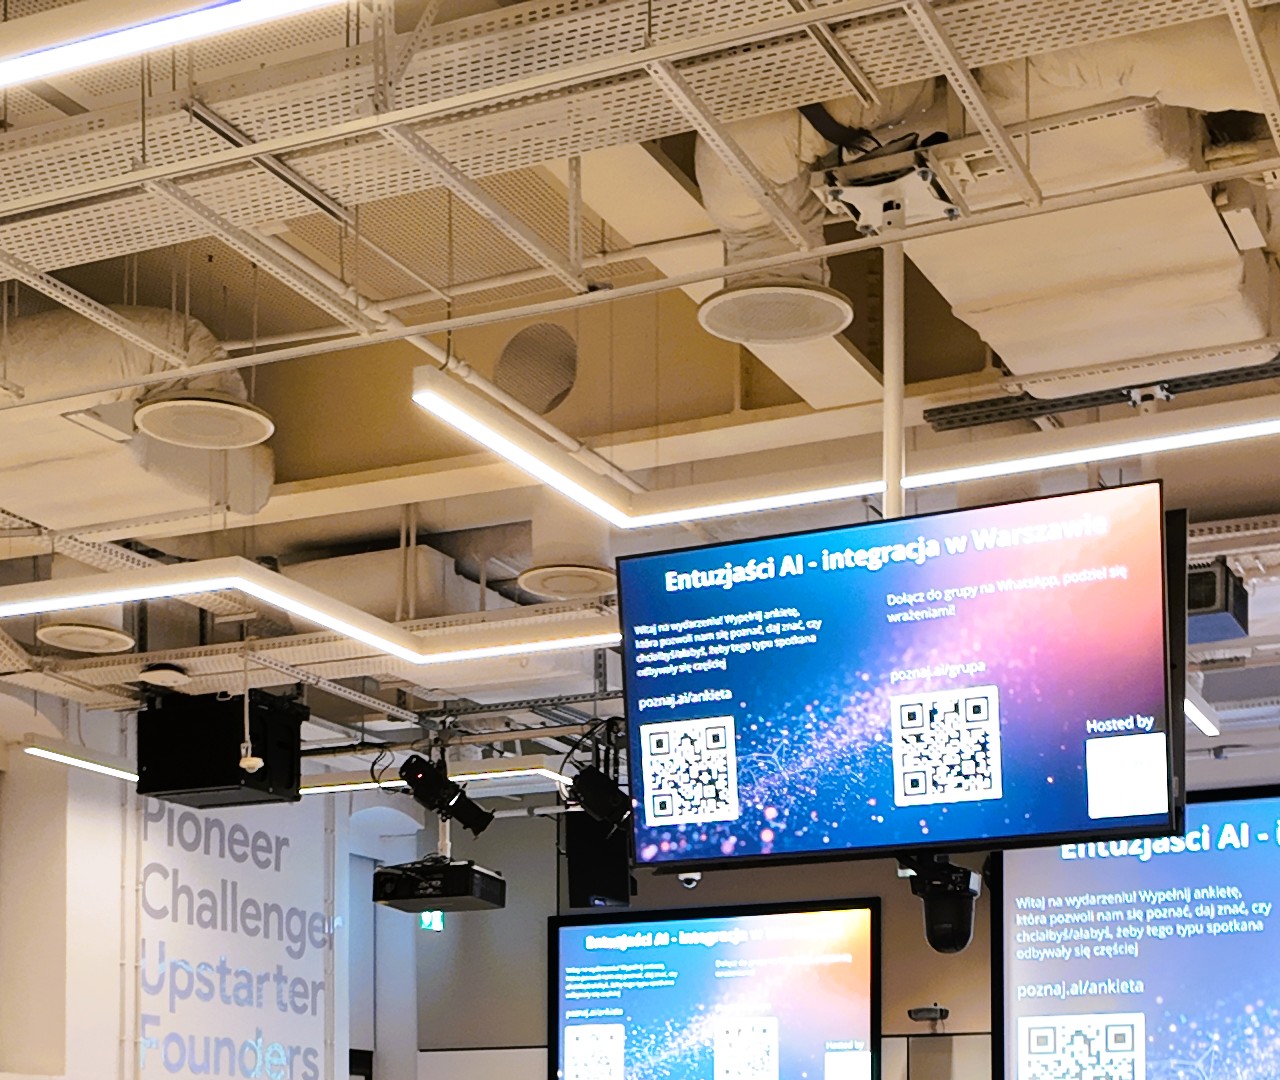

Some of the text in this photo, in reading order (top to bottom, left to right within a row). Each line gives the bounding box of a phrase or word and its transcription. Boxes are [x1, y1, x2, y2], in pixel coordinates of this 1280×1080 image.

[665, 561, 776, 592] Entuzjaści
[779, 554, 804, 575] AI
[822, 535, 940, 573] integracja
[945, 534, 968, 554] w
[972, 512, 1108, 550] Warszawie
[886, 593, 924, 607] Dołącz
[927, 589, 942, 600] do
[944, 585, 978, 602] grupy
[980, 583, 995, 594] na
[890, 661, 986, 684] poznaj.ai/grupa
[638, 689, 732, 711] poznaj.ai/ankieta
[1086, 714, 1154, 733] Hosted by
[143, 797, 290, 872] Pioneer
[1218, 822, 1249, 850] AI
[1015, 896, 1046, 910] Witaj
[1048, 897, 1063, 907] na
[1049, 909, 1094, 927] pozwoli
[1097, 911, 1124, 922] nam
[1195, 904, 1215, 918] daj
[1251, 902, 1272, 917] czy
[1146, 926, 1174, 939] tego
[1176, 923, 1203, 937] typu
[141, 938, 326, 1016] Upstarter
[1017, 978, 1145, 1000] poznaj.ai/ankieta
